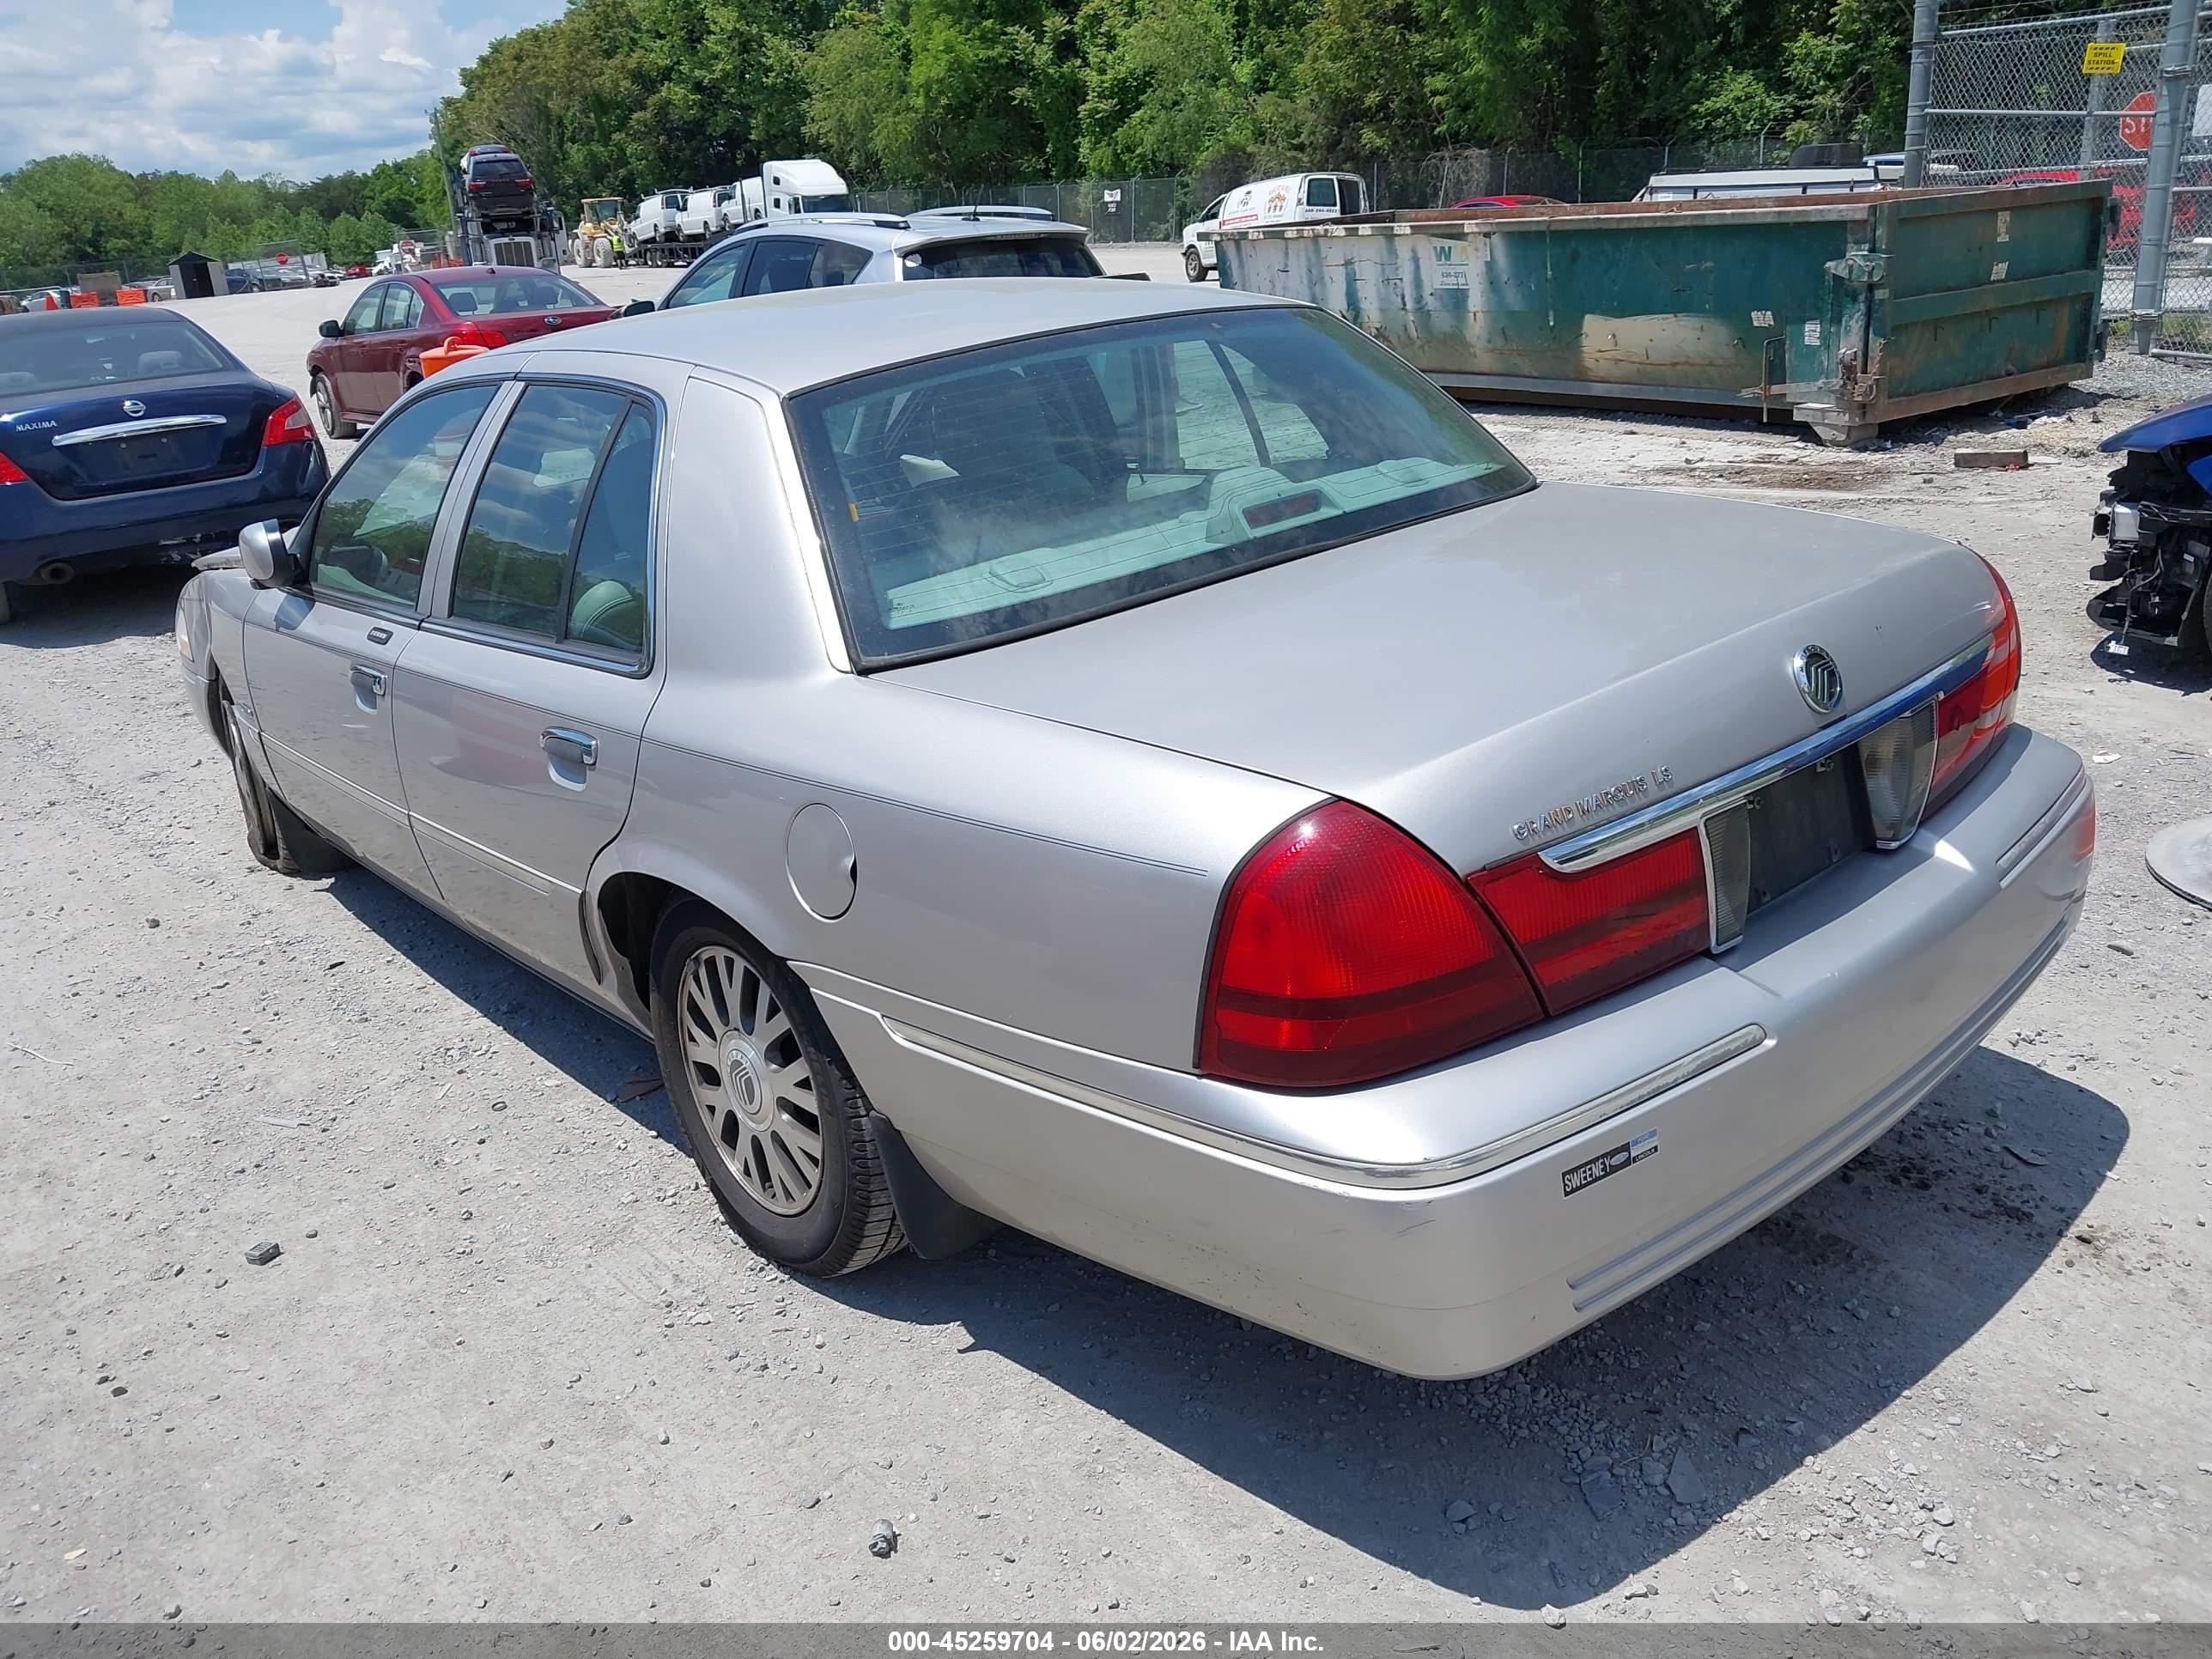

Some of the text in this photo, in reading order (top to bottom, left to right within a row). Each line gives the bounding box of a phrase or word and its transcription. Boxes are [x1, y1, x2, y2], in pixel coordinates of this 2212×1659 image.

[15, 420, 58, 432] MAXIMA
[1511, 764, 1674, 841] GRAND MARQUIS LS
[1635, 1147, 1656, 1162] LINCOLN
[1564, 1155, 1611, 1192] SWEENEY
